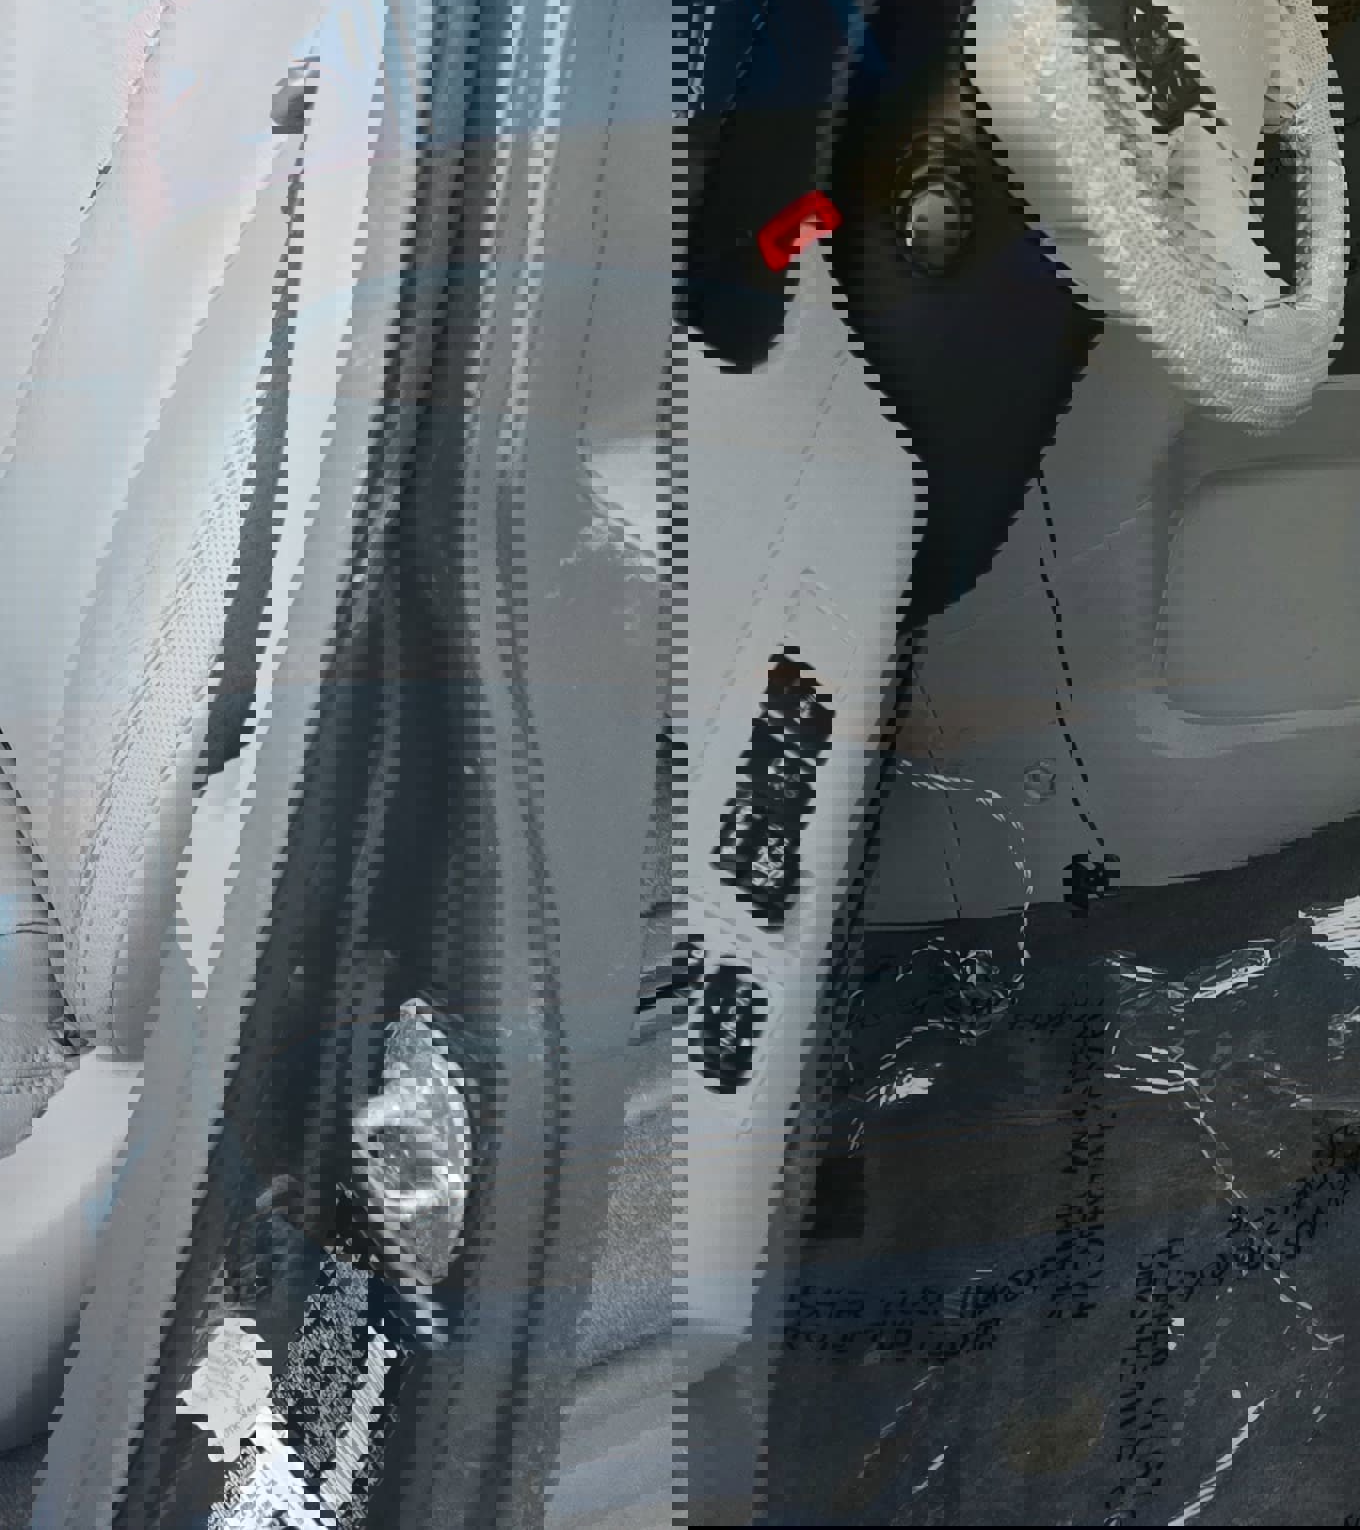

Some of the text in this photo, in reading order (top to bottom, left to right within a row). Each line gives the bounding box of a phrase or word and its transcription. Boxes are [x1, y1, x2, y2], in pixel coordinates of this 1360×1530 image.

[65, 1089, 99, 1210] REMOVE
[74, 1234, 120, 1343] MUST
[128, 1261, 187, 1526] PROTECTIVE
